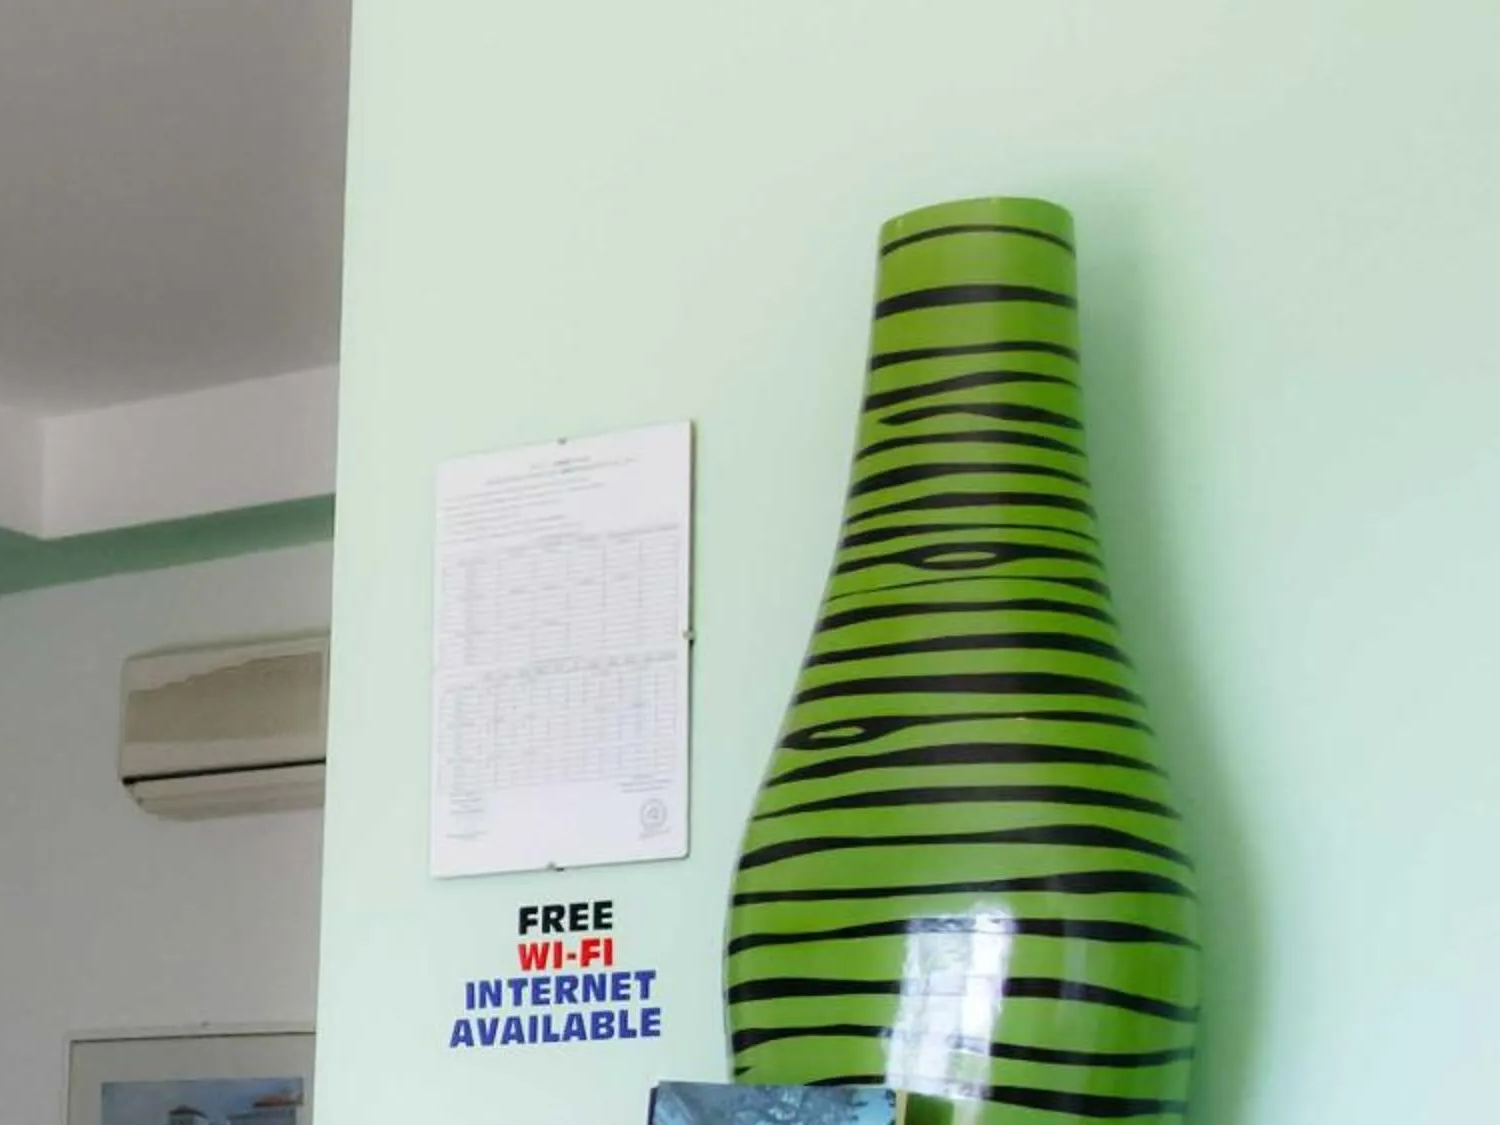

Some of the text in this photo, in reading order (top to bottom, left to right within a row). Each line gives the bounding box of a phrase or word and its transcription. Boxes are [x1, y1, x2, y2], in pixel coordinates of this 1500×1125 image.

[518, 900, 613, 935] FREE
[517, 938, 613, 971] WI-FI
[465, 969, 656, 1010] INTERNET
[449, 1007, 661, 1048] AVAILABLE
